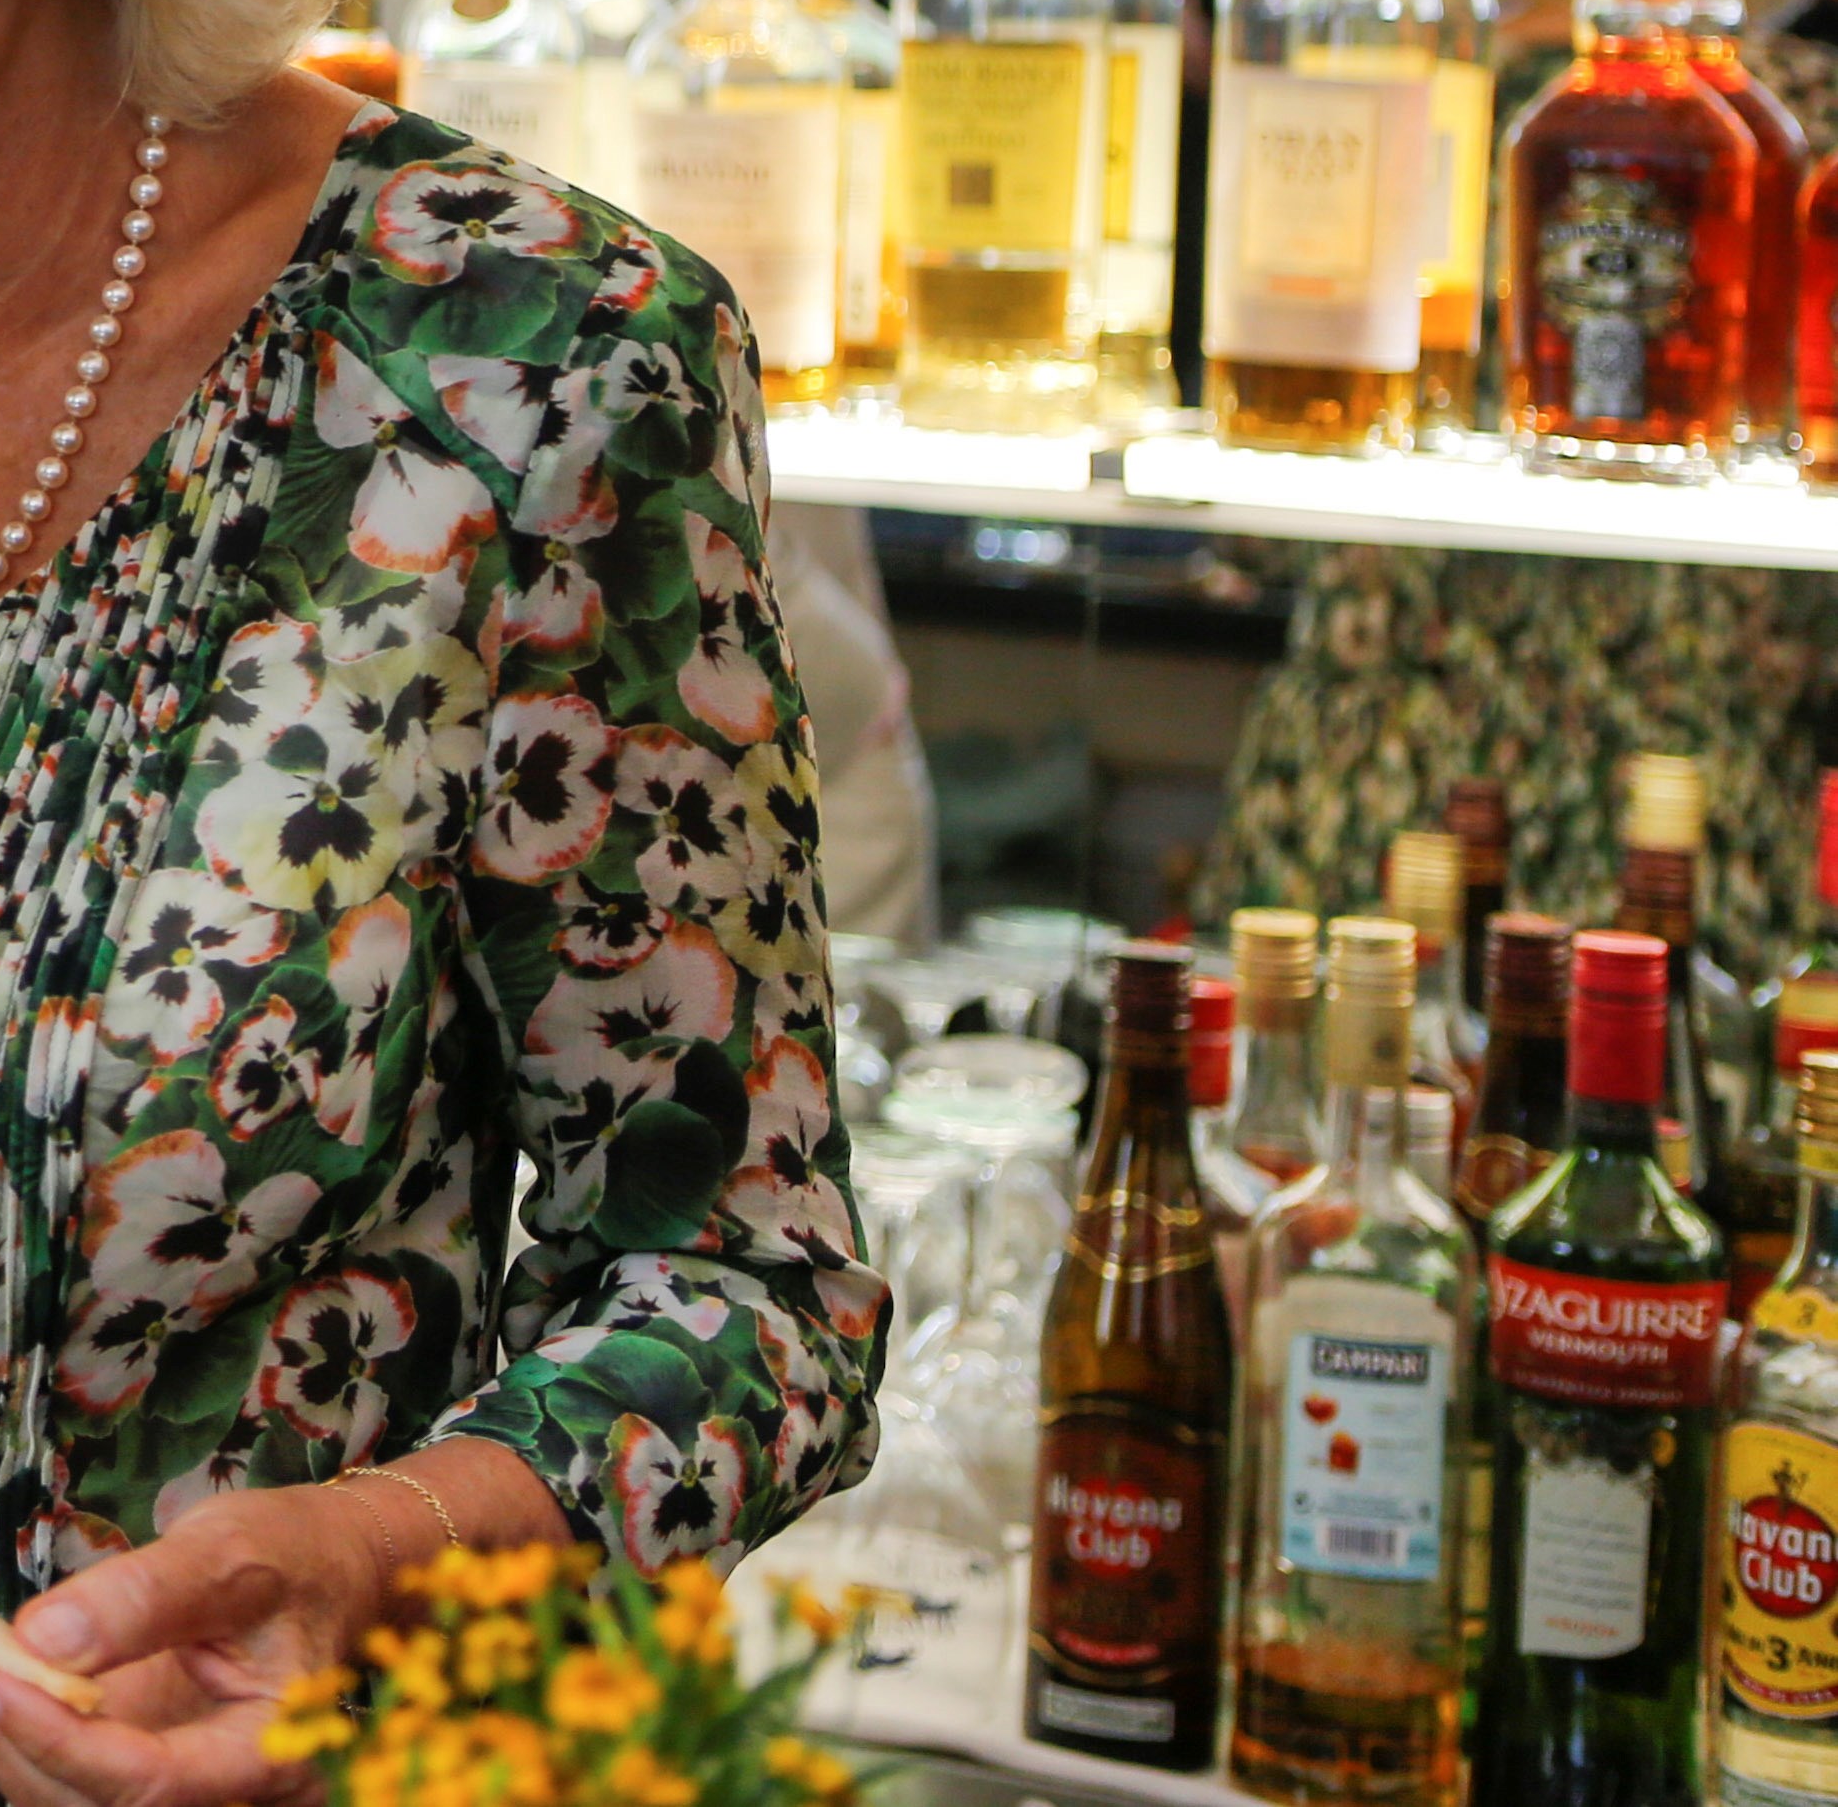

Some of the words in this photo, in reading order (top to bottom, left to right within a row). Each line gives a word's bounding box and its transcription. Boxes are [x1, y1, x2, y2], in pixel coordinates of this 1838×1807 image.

[1527, 1327, 1669, 1366] VERMOUTH
[1048, 1472, 1183, 1533] Havana
[1067, 1521, 1152, 1569] Club
[1727, 1497, 1838, 1564] Havan
[1740, 1548, 1823, 1604] Club
[1766, 1634, 1791, 1673] 3
